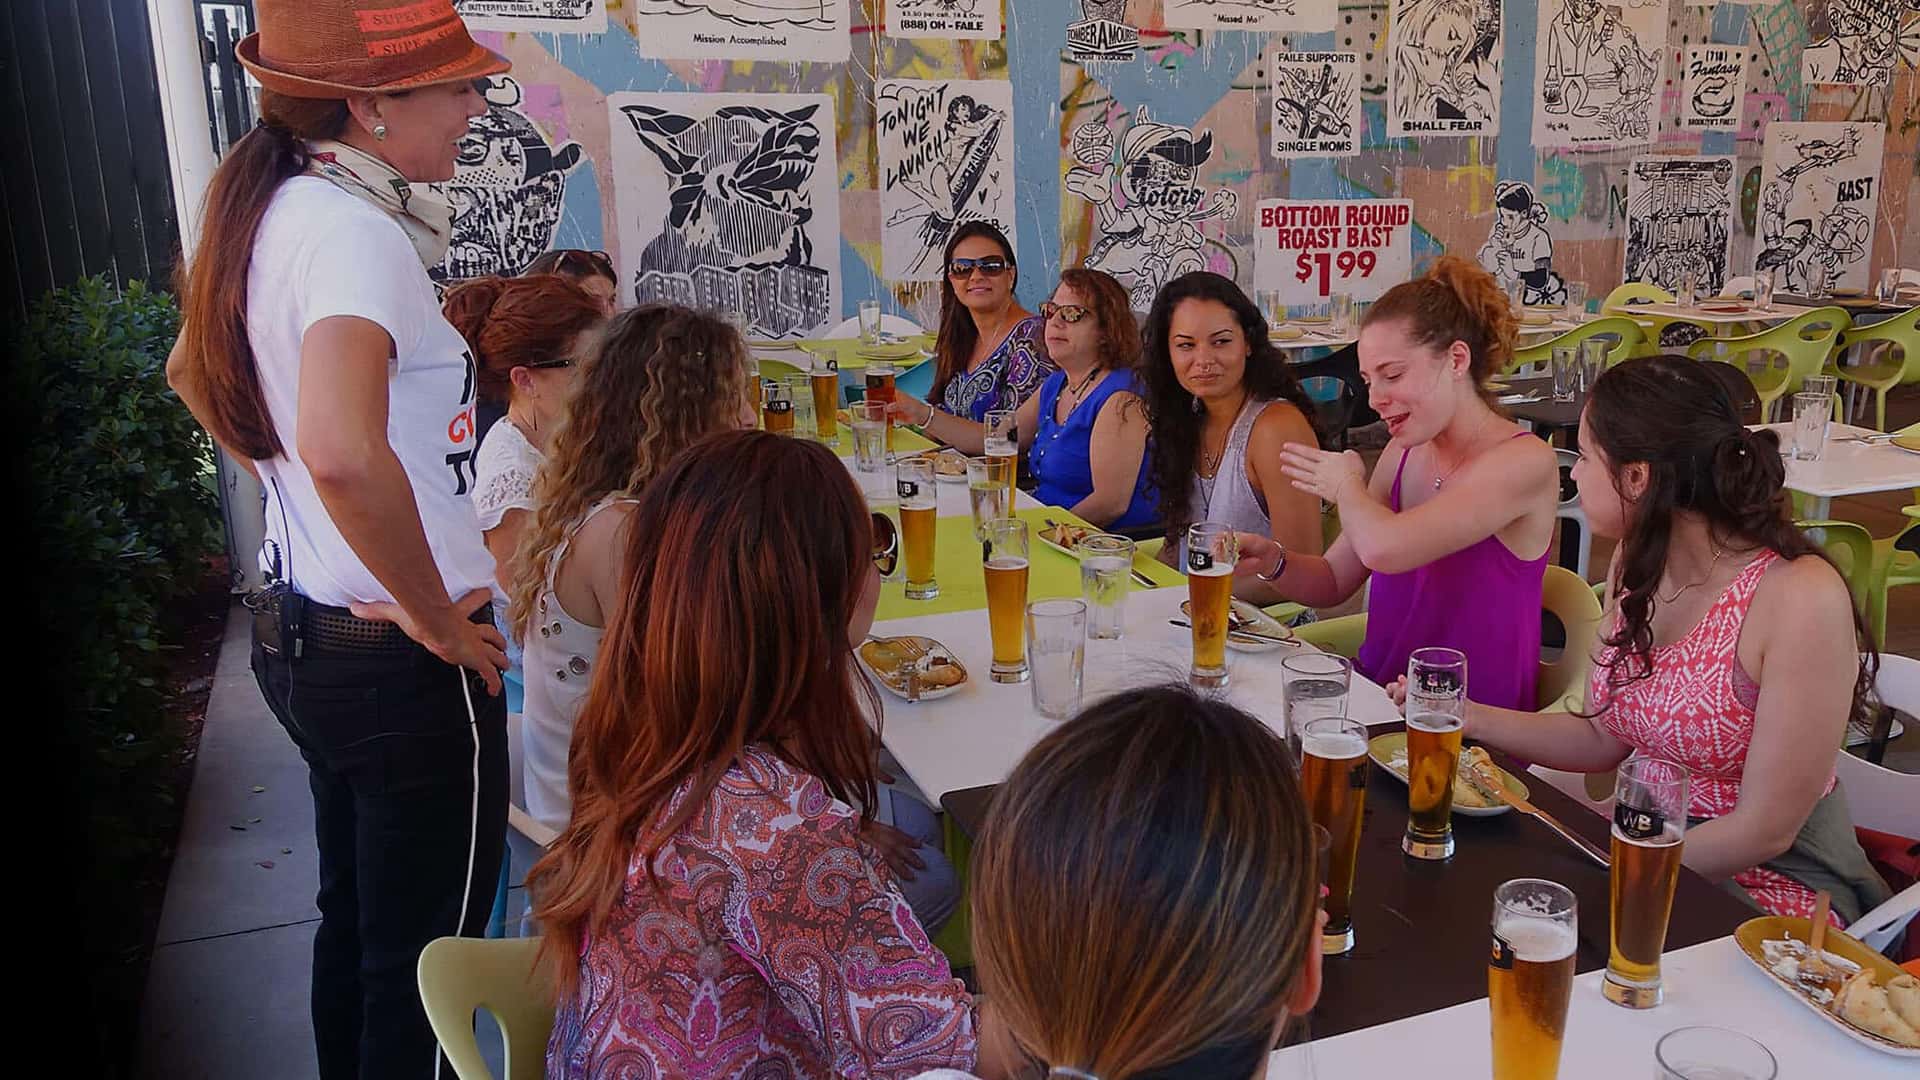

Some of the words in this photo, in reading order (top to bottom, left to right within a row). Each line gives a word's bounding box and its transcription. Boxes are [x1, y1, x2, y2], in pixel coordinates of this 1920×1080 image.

[550, 8, 576, 18] SOCIAL
[900, 20, 928, 32] (888)
[929, 20, 946, 30] OH
[954, 21, 984, 31] FAILE
[693, 33, 726, 45] Mission
[729, 34, 787, 47] Accomplished
[1277, 53, 1304, 63] FAILE
[1305, 53, 1356, 63] SUPPORTS
[1690, 60, 1742, 79] Fantasy
[878, 83, 948, 137] TONIGHT
[903, 120, 930, 149] WE
[1402, 121, 1446, 131] SHALL
[1449, 121, 1482, 131] FEAR
[1277, 141, 1317, 152] SINGLE
[1318, 141, 1352, 152] MOMS
[887, 129, 945, 192] LAUNCH
[1651, 179, 1713, 217] FAILE
[1837, 176, 1873, 202] BAST
[1261, 206, 1340, 228] BOTTOM
[1346, 204, 1410, 226] ROUND
[1278, 227, 1342, 249] ROAST
[1346, 226, 1394, 248] BAST
[1622, 811, 1652, 830] WB
